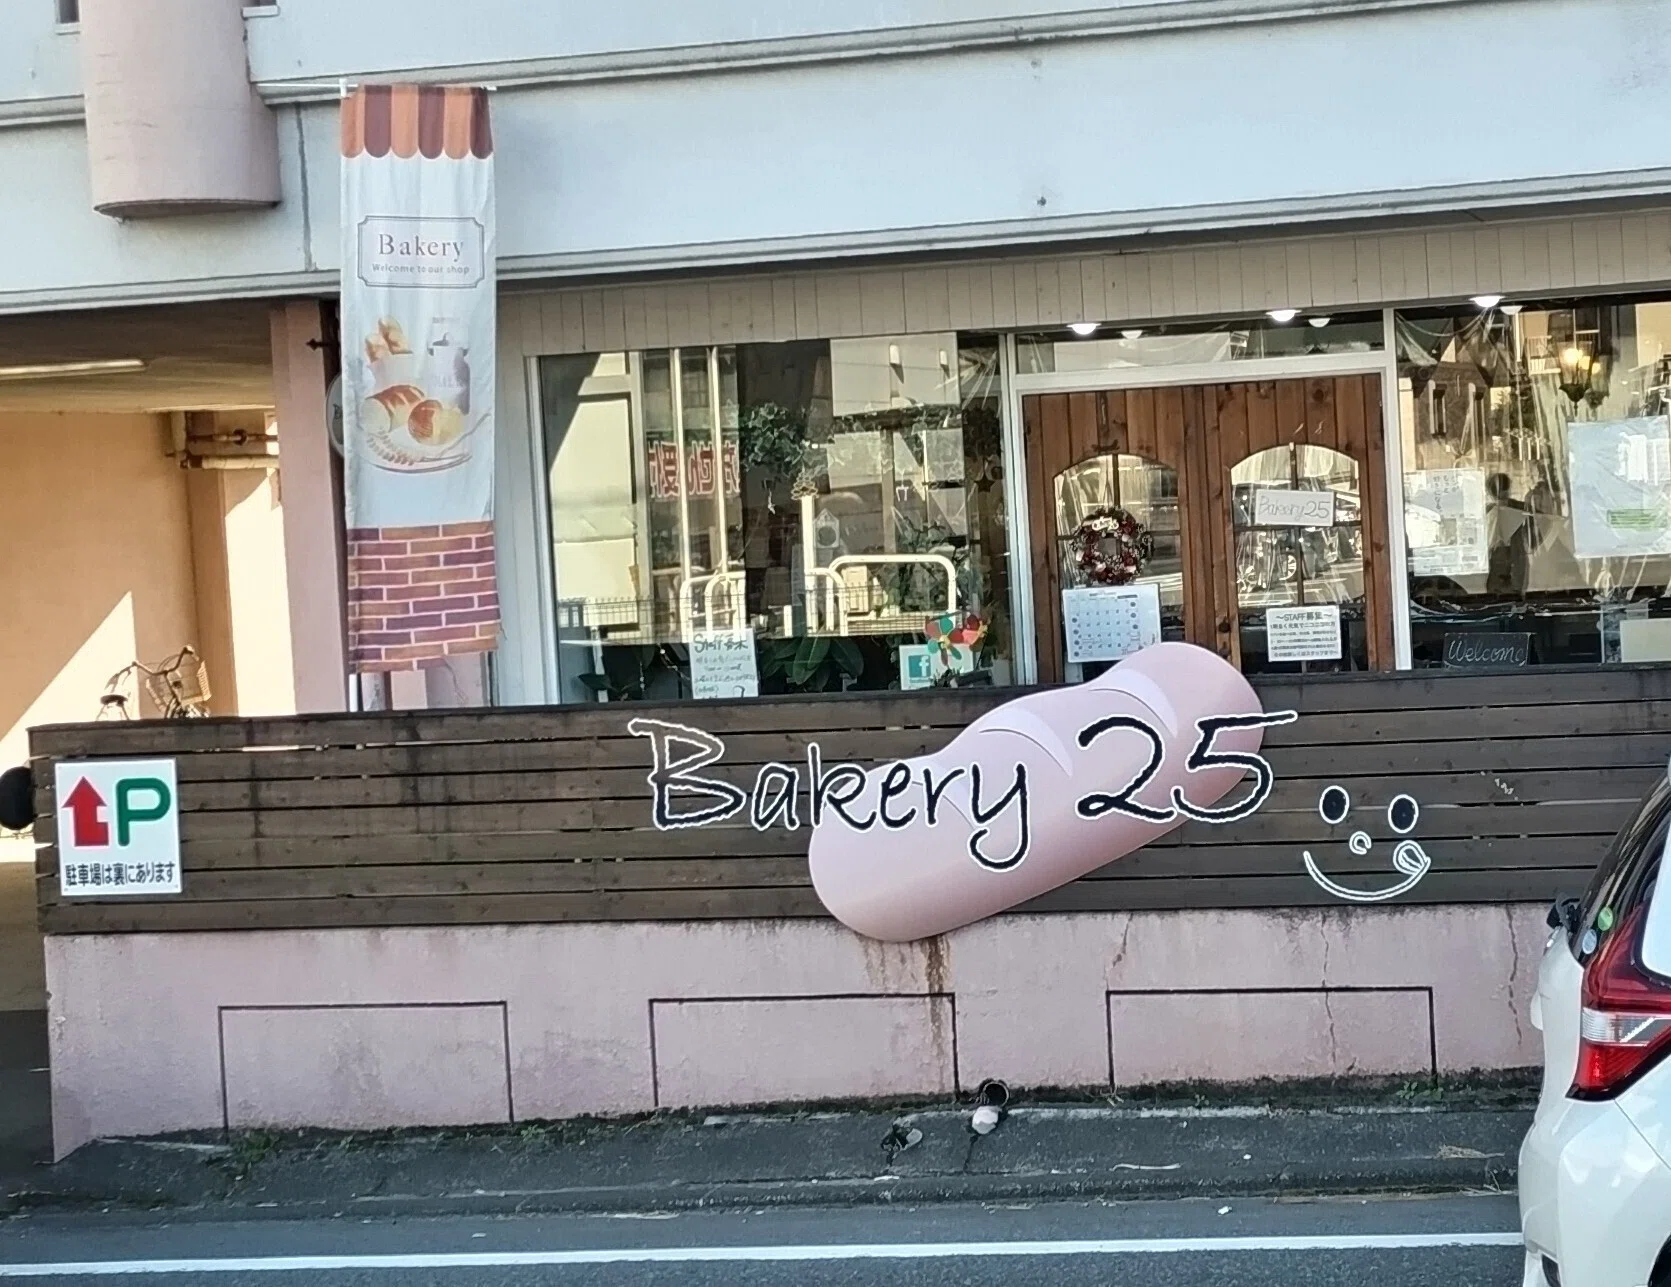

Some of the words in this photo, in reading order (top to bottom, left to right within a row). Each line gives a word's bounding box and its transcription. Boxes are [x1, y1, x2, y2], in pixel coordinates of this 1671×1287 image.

[378, 233, 465, 262] Bakery
[371, 263, 414, 273] Welcome
[417, 263, 426, 273] to
[427, 266, 444, 274] our
[446, 264, 471, 275] shop
[1448, 639, 1524, 663] Welcome
[627, 716, 1030, 873] Bakery
[1075, 709, 1298, 826] 25
[116, 777, 171, 847] P
[65, 861, 176, 887] 駐車場は裏にあります
